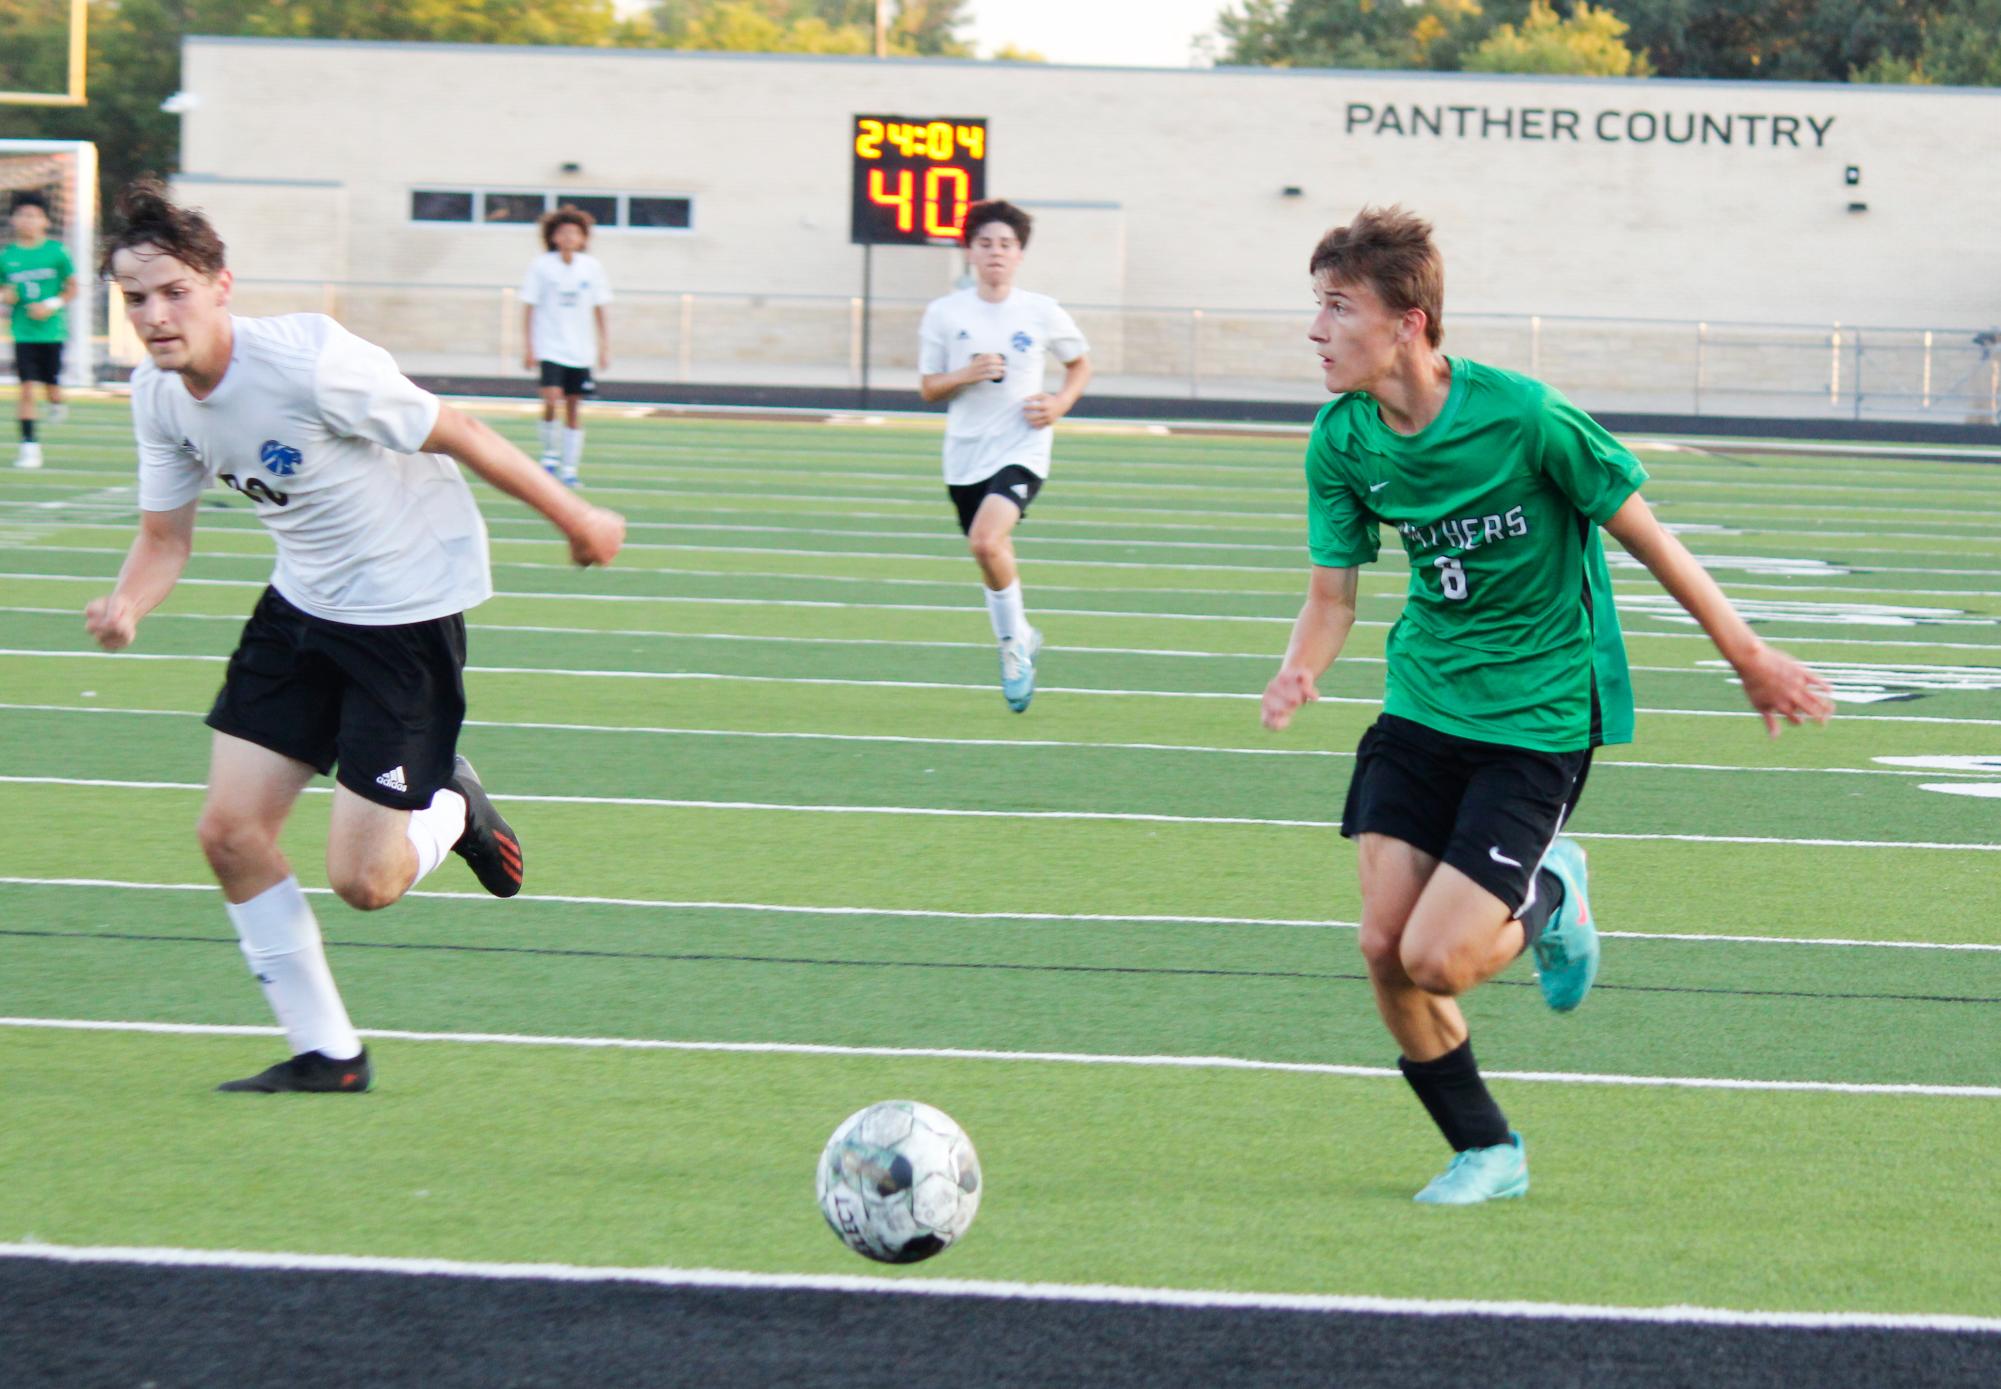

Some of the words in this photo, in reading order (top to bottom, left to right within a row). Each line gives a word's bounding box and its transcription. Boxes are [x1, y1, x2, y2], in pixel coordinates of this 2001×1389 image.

[855, 119, 985, 160] 24:04
[1346, 102, 1580, 140] PANTHER
[1595, 110, 1835, 147] COUNTRY
[868, 166, 971, 238] 40
[1433, 555, 1468, 600] 8
[376, 776, 407, 793] adidas
